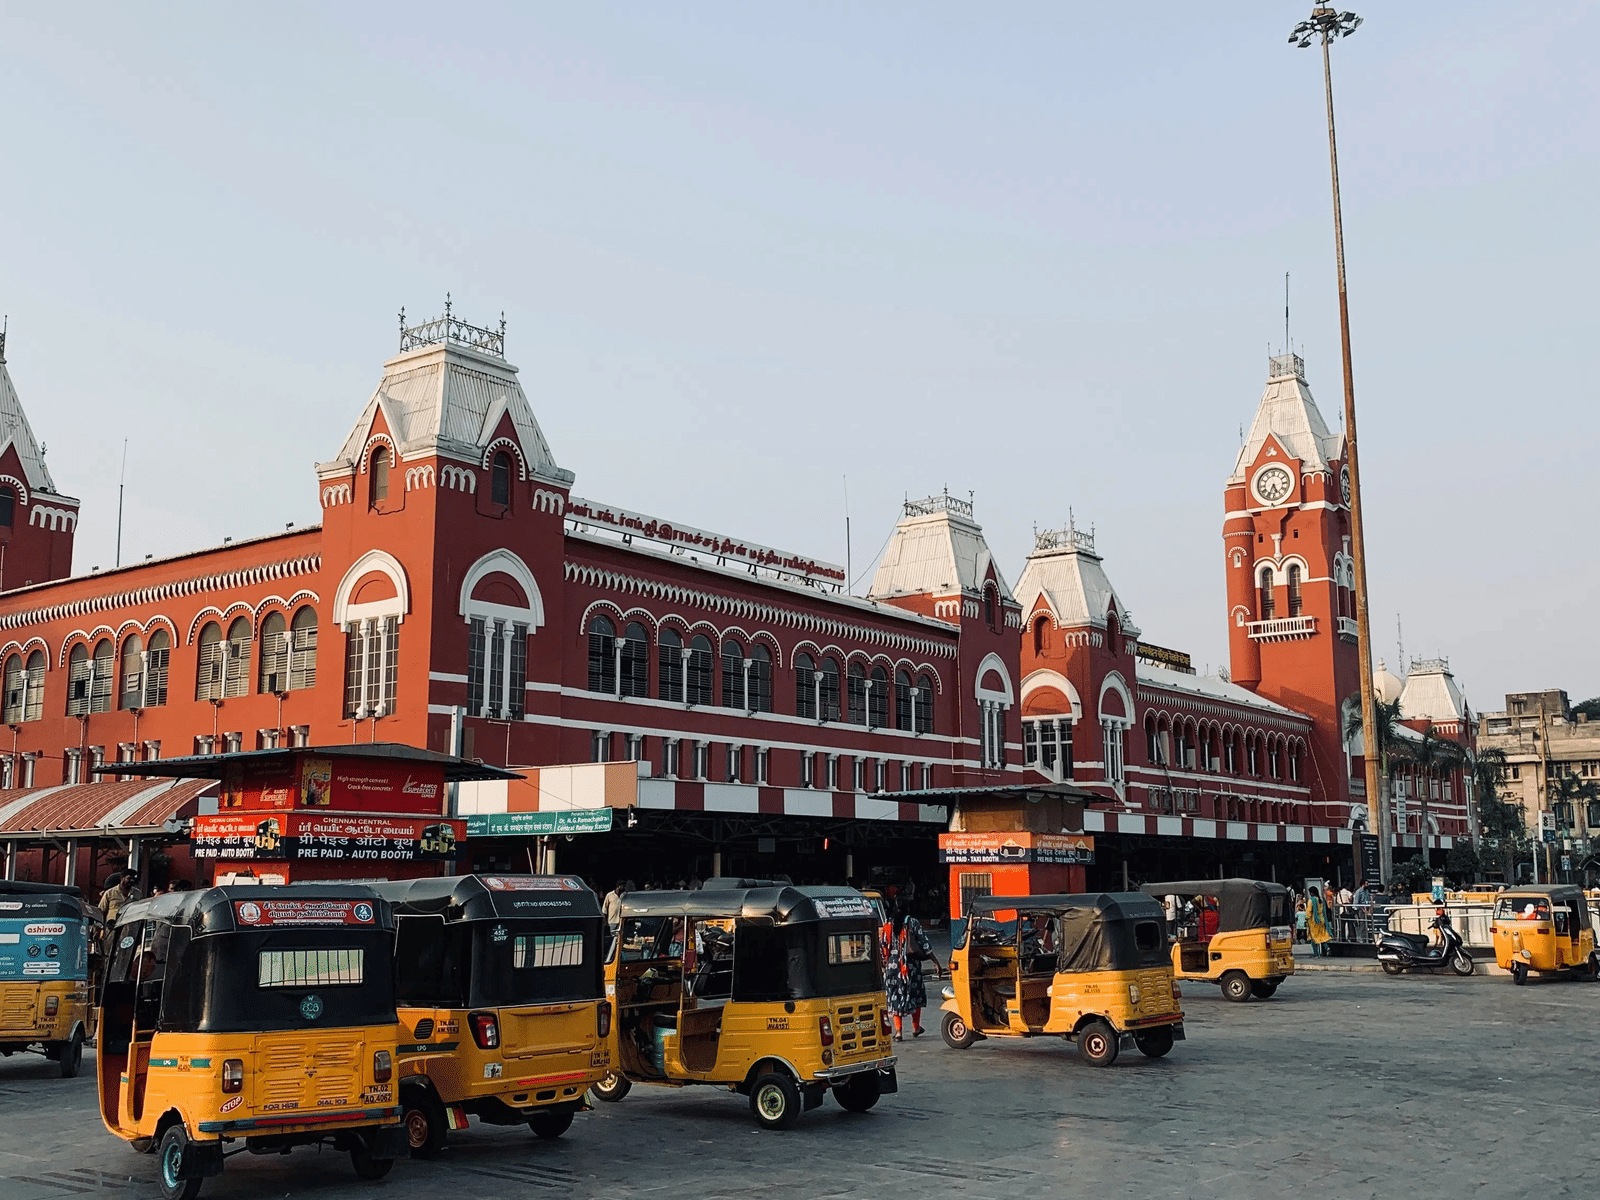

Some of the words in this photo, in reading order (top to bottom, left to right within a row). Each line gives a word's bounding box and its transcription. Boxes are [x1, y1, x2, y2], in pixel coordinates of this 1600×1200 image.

[323, 817, 356, 825] CHENNAI
[345, 825, 381, 835] ஆட்டோ
[383, 825, 415, 835] மையம்
[355, 834, 388, 847] ऑटो
[195, 848, 206, 858] PRE
[206, 848, 217, 858] PAID
[220, 848, 235, 858] AUTO
[235, 848, 254, 858] BOOTH
[297, 848, 318, 858] PRE
[320, 848, 344, 859] PAID
[351, 849, 379, 859] AUTO
[380, 850, 414, 860] BOOTH
[28, 925, 63, 933] ashirvad
[368, 1084, 389, 1093] TN.02
[223, 1096, 241, 1112] STOP
